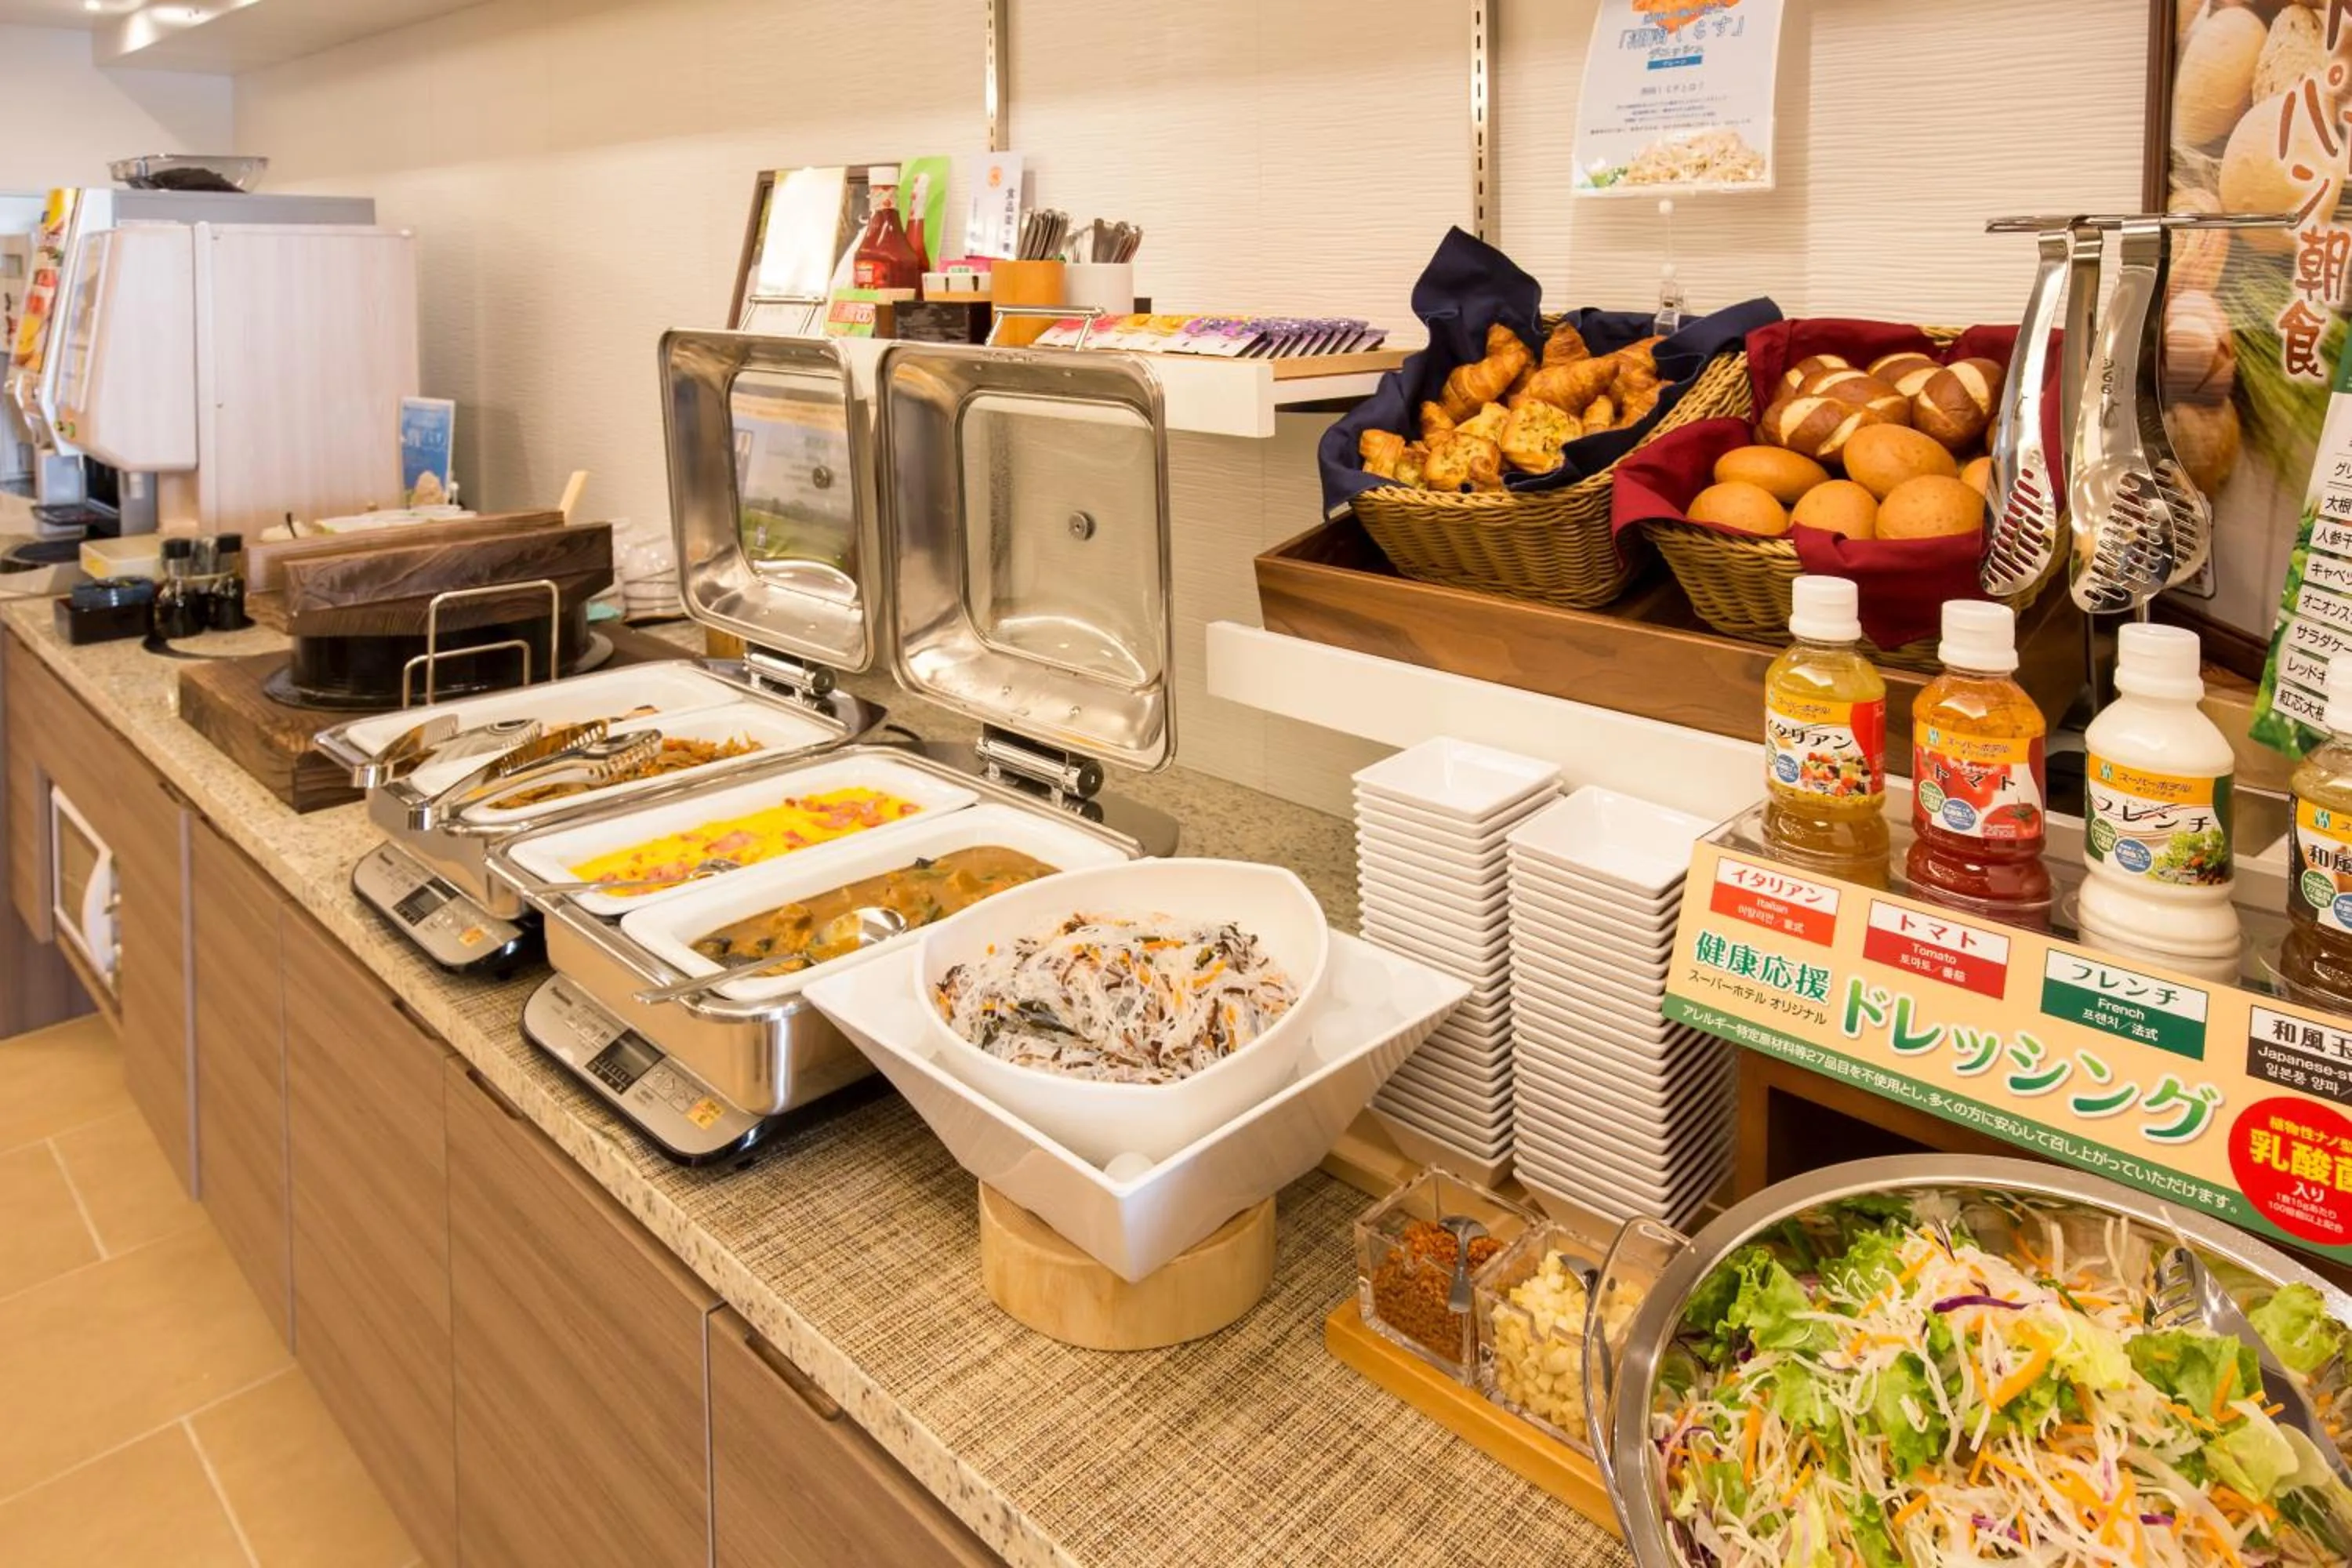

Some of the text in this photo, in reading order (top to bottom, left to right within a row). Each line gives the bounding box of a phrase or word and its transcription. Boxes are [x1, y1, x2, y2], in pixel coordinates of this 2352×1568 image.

[2303, 593, 2352, 624] オニオンス
[1936, 764, 2016, 791] トマト
[2098, 795, 2211, 833] フレンチ
[1731, 869, 1823, 903] イタリアン
[1756, 898, 1788, 914] Italian
[1900, 913, 1977, 949] トマト
[1695, 931, 1830, 1004] 健康応援
[1911, 942, 1957, 965] Tomato
[1688, 968, 1828, 1025] スーパーホテル オリジナル
[2071, 963, 2180, 1005] フレンチ
[2096, 997, 2145, 1021] French
[2272, 1019, 2352, 1058] 和風玉
[1843, 976, 2220, 1142] ドレッシング
[2292, 1181, 2325, 1203] 入り
